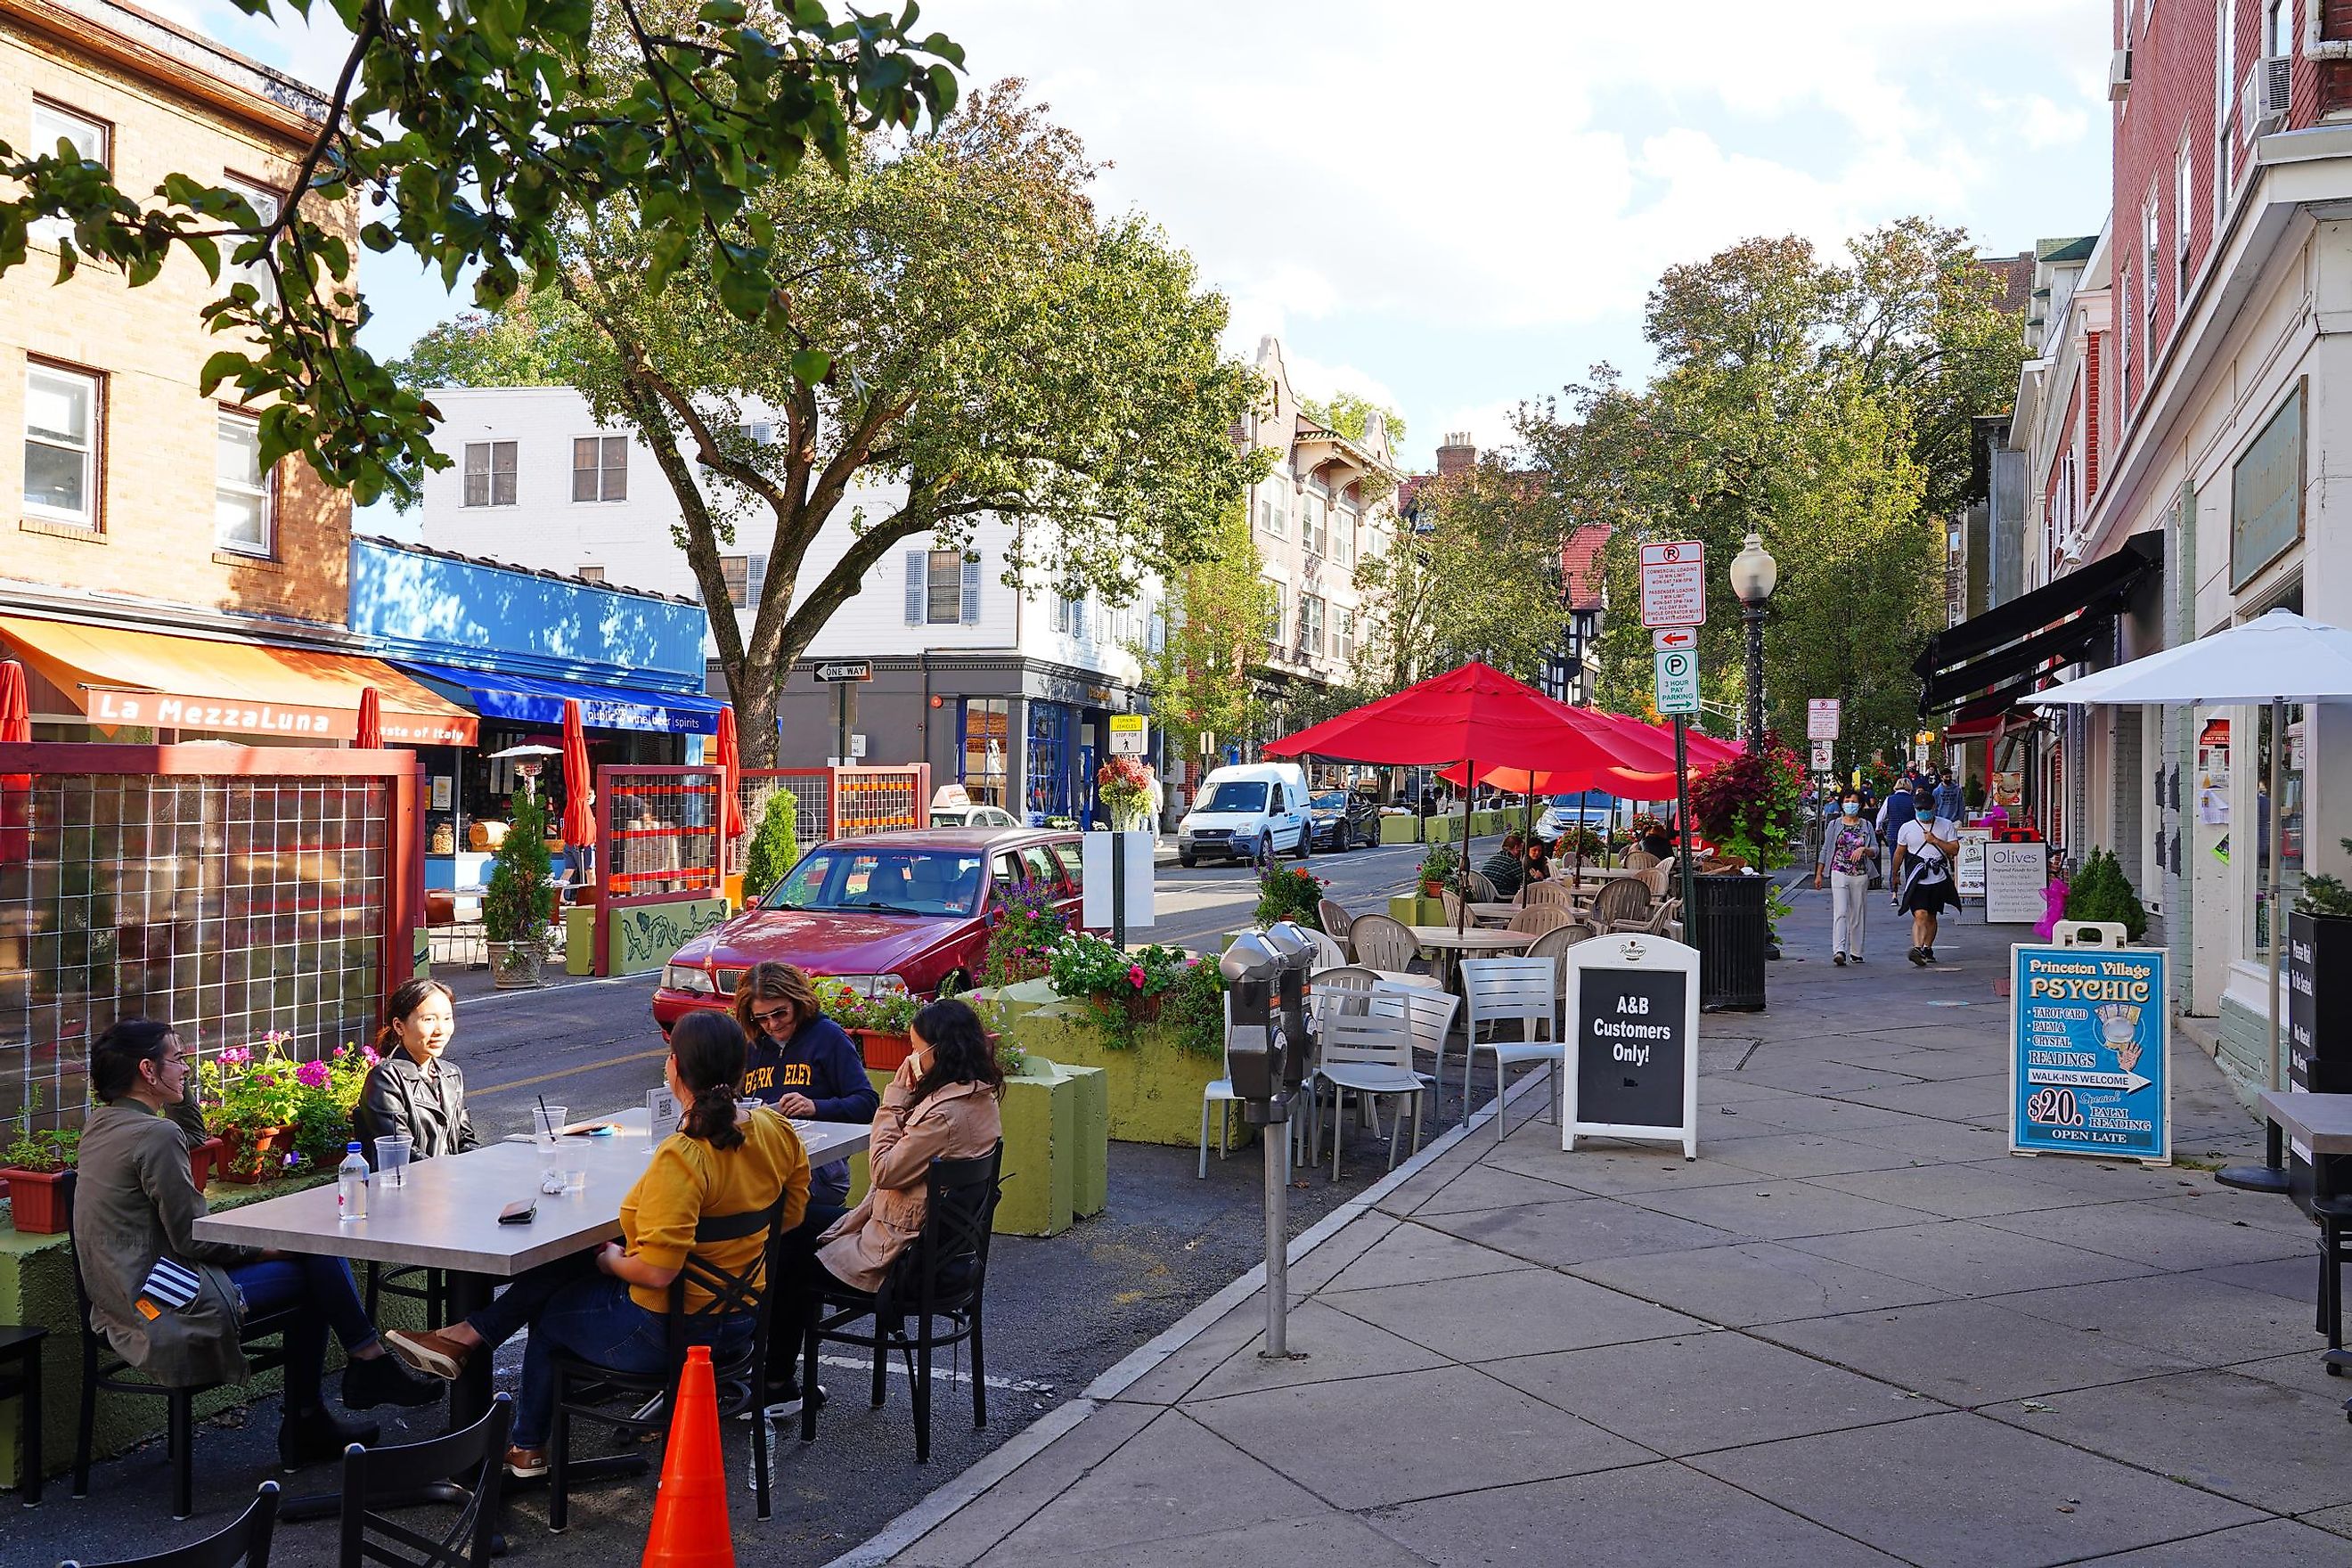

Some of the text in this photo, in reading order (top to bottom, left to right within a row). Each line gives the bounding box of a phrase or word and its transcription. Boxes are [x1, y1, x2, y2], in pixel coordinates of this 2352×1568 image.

[826, 666, 865, 676] ONE WAY
[1662, 693, 1693, 701] PARKING
[100, 694, 330, 733] La MezzaLuna
[588, 709, 699, 729] public wine beer spirits
[413, 726, 428, 739] of
[433, 727, 464, 743] Italy
[1993, 849, 2038, 863] Olives
[2029, 959, 2152, 980] Princeton Village
[2029, 976, 2151, 1003] PSYCHIC
[1616, 995, 1649, 1015] A&B
[2033, 1007, 2088, 1019] TAROT CARD
[1593, 1017, 1671, 1040] Customers
[2033, 1022, 2066, 1033] PALM &
[2032, 1035, 2071, 1048] CRYSTAL
[1613, 1042, 1650, 1066] Only!
[2029, 1050, 2095, 1068] READINGS
[2031, 1072, 2129, 1086] WALK-INS WELCOME
[2079, 1091, 2121, 1106] Special
[2090, 1107, 2128, 1119] PALM
[2088, 1118, 2152, 1131] READING
[2052, 1129, 2127, 1143] OPEN LATE
